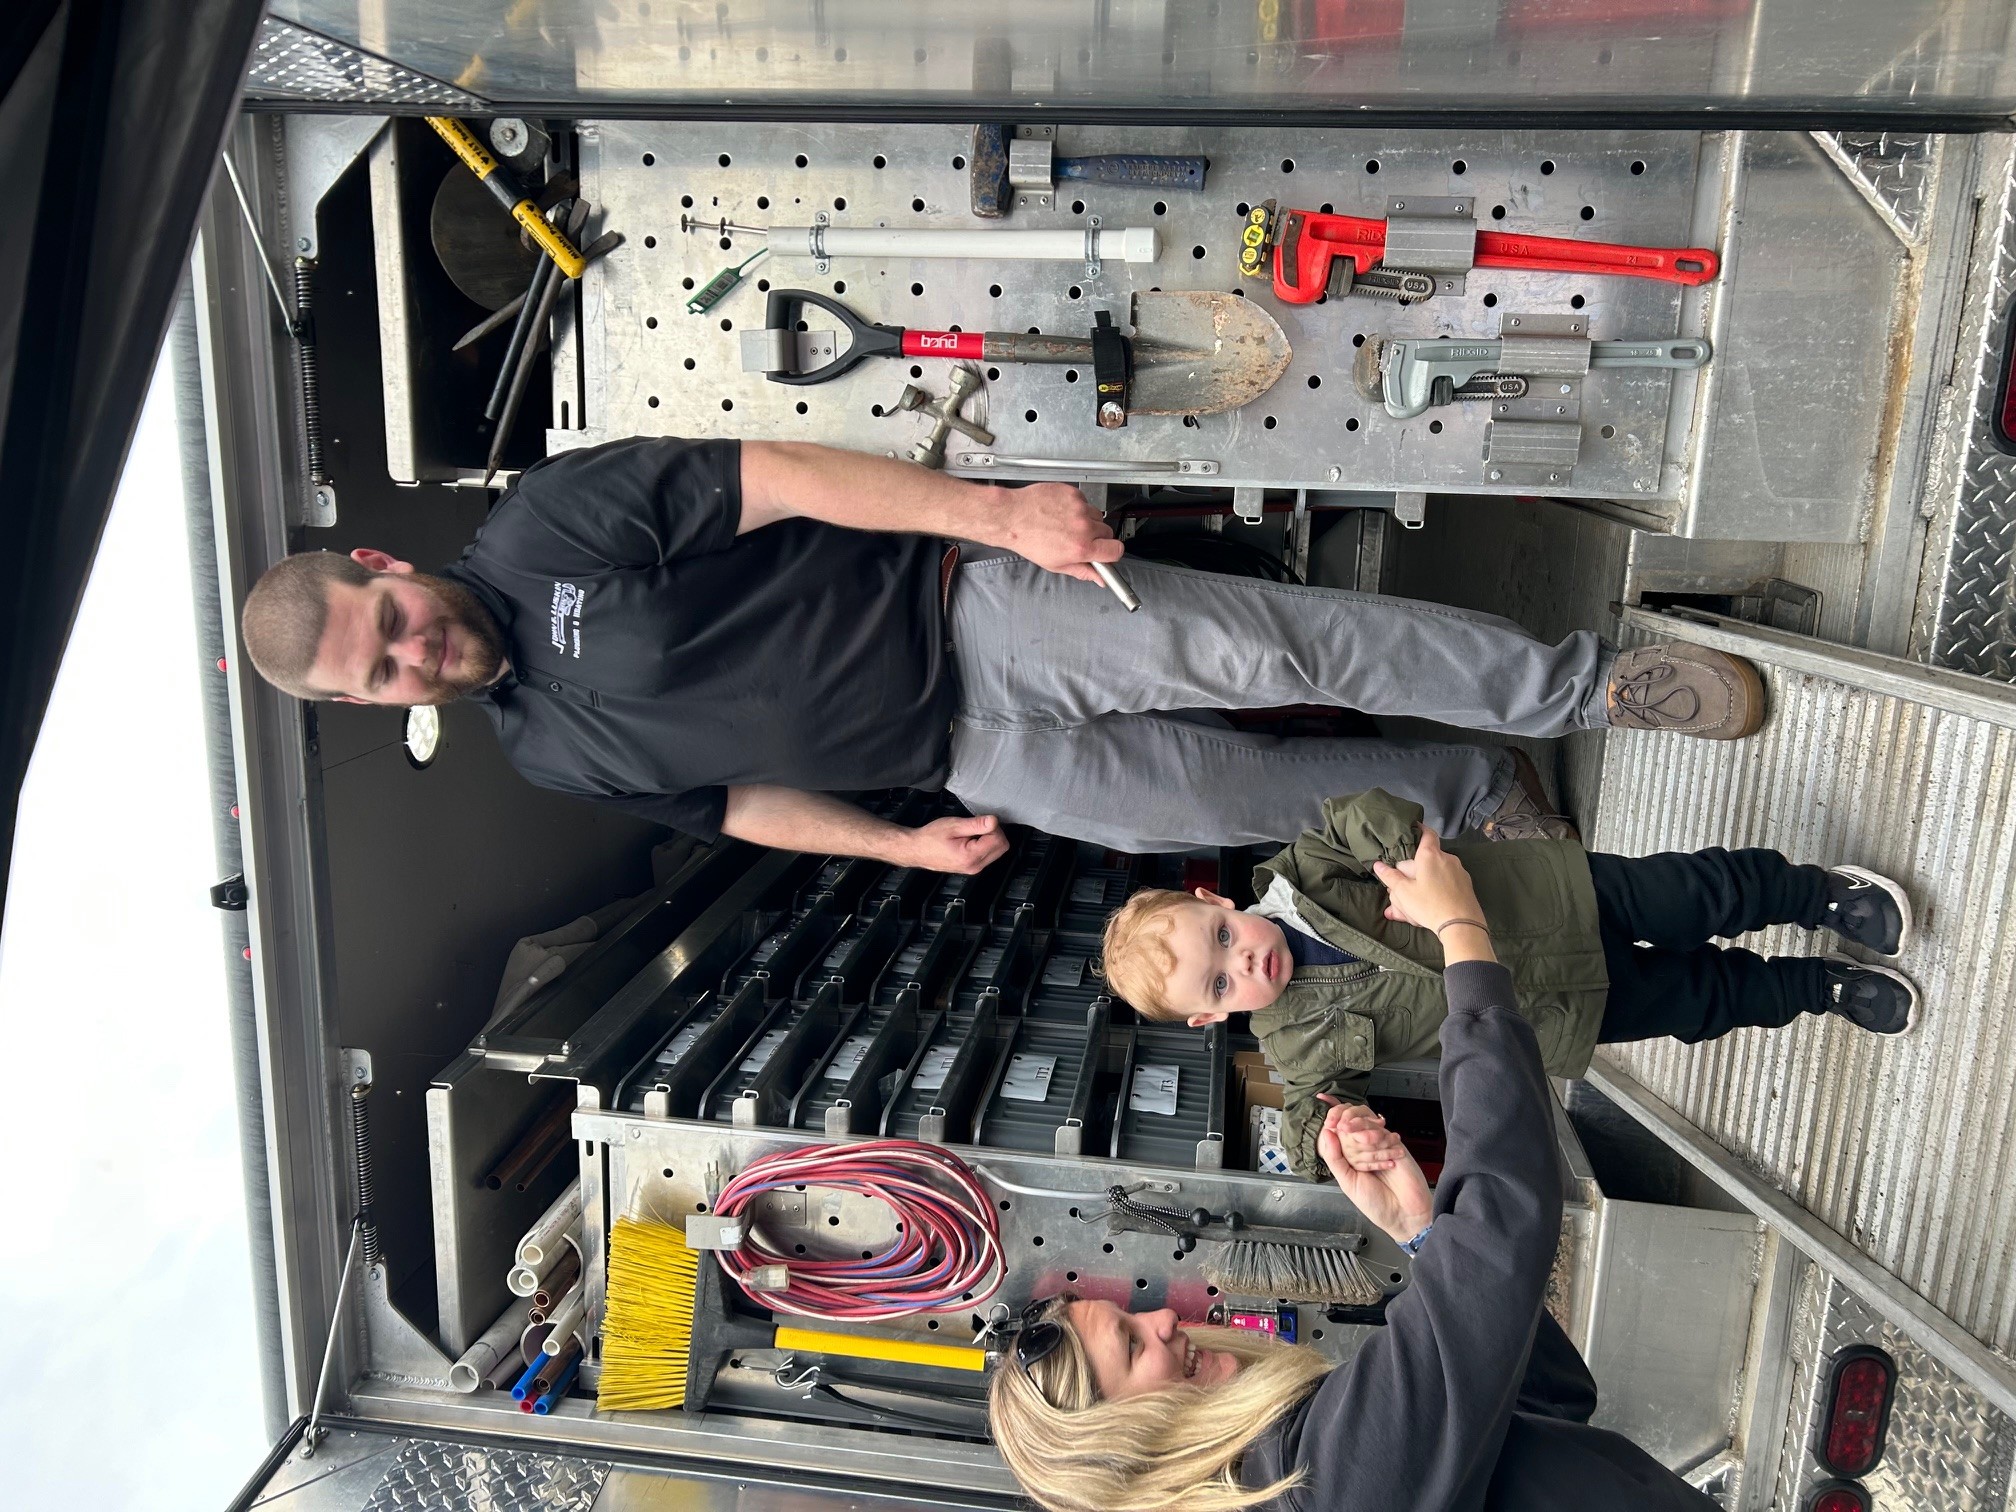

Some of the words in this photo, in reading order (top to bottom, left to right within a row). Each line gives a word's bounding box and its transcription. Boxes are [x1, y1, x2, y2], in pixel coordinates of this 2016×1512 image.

[557, 236, 580, 260] Mighty
[1500, 242, 1529, 255] USA
[1407, 281, 1426, 290] USA
[921, 334, 958, 348] bond
